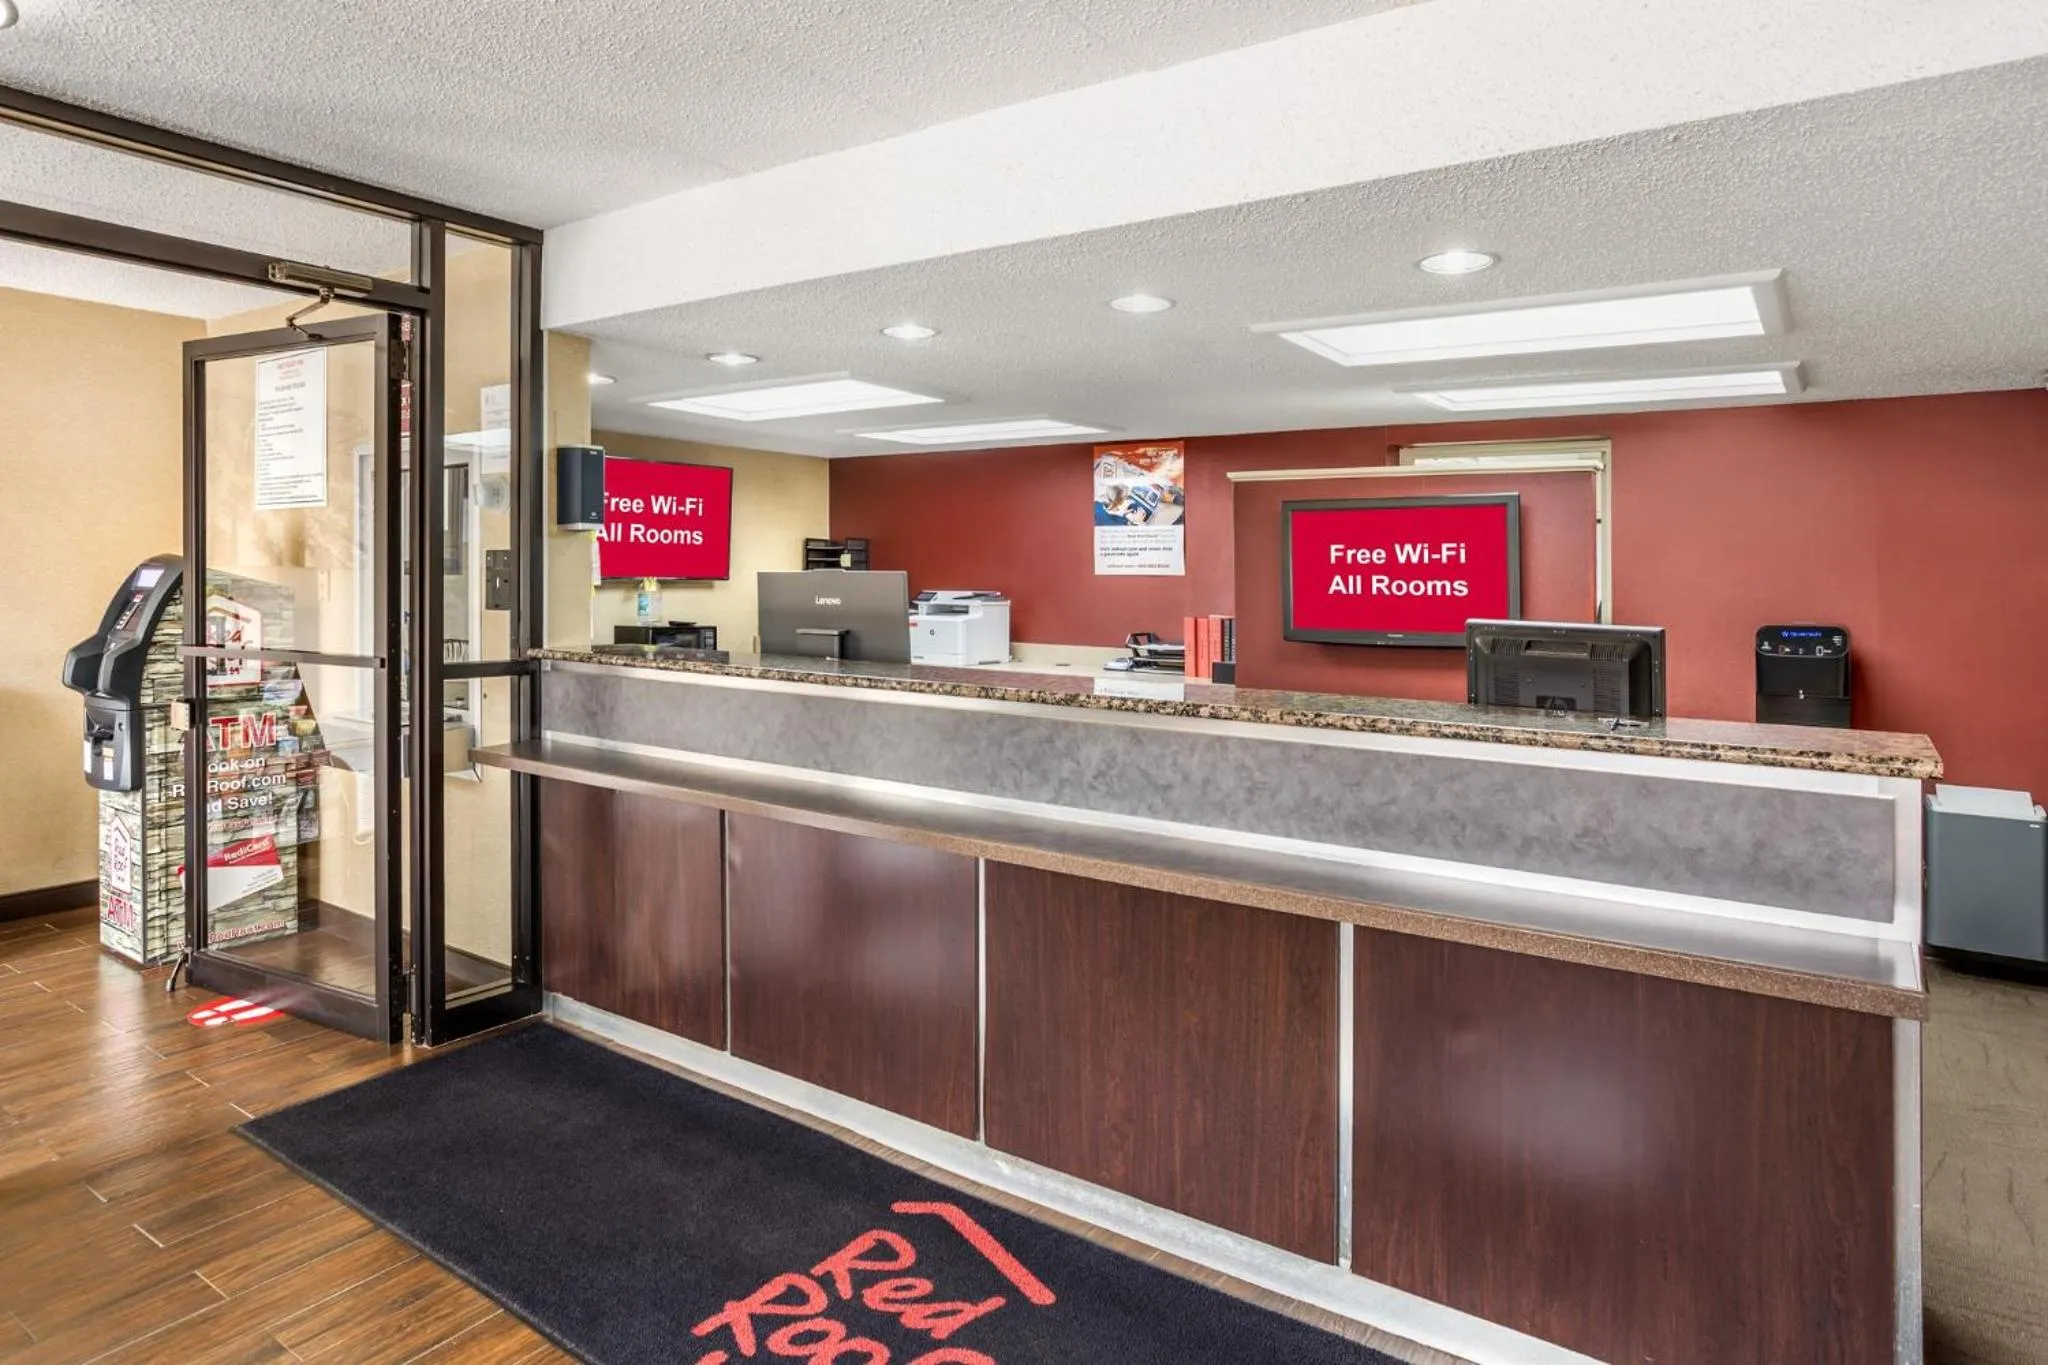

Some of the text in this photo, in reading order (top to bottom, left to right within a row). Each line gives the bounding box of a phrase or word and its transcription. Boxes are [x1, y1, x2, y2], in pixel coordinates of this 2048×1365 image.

[651, 495, 703, 516] Wi-Fi
[629, 523, 703, 545] Rooms
[1329, 542, 1466, 564] Free Wi-Fi
[1327, 574, 1469, 596] All Rooms
[207, 758, 240, 773] ook
[172, 774, 286, 798] RRoof.com
[227, 791, 273, 810] Save!
[811, 1230, 1006, 1340] Red
